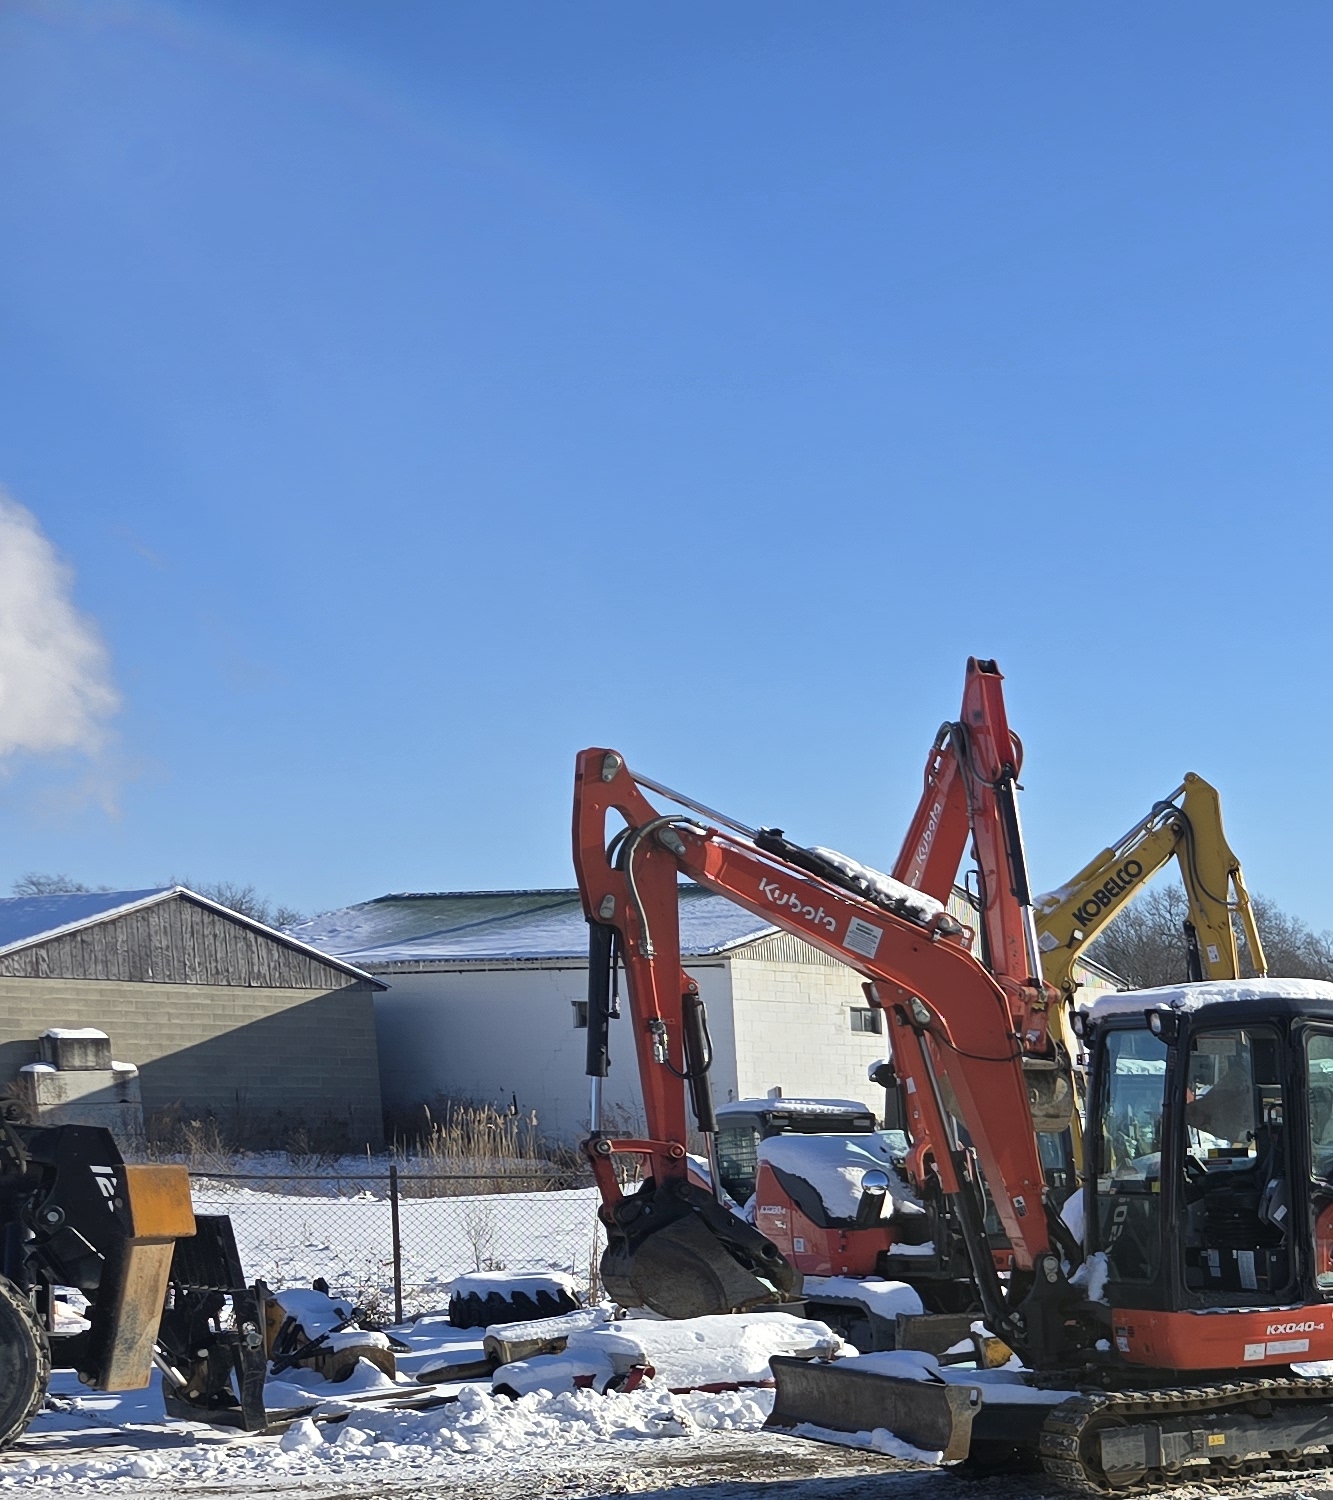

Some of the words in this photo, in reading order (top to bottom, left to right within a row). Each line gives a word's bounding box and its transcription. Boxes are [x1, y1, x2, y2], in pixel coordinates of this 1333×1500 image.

[915, 802, 942, 864] Kubota
[758, 877, 837, 932] Kubota
[1071, 859, 1143, 928] KOBELCO
[1266, 1321, 1325, 1335] KX040-4
